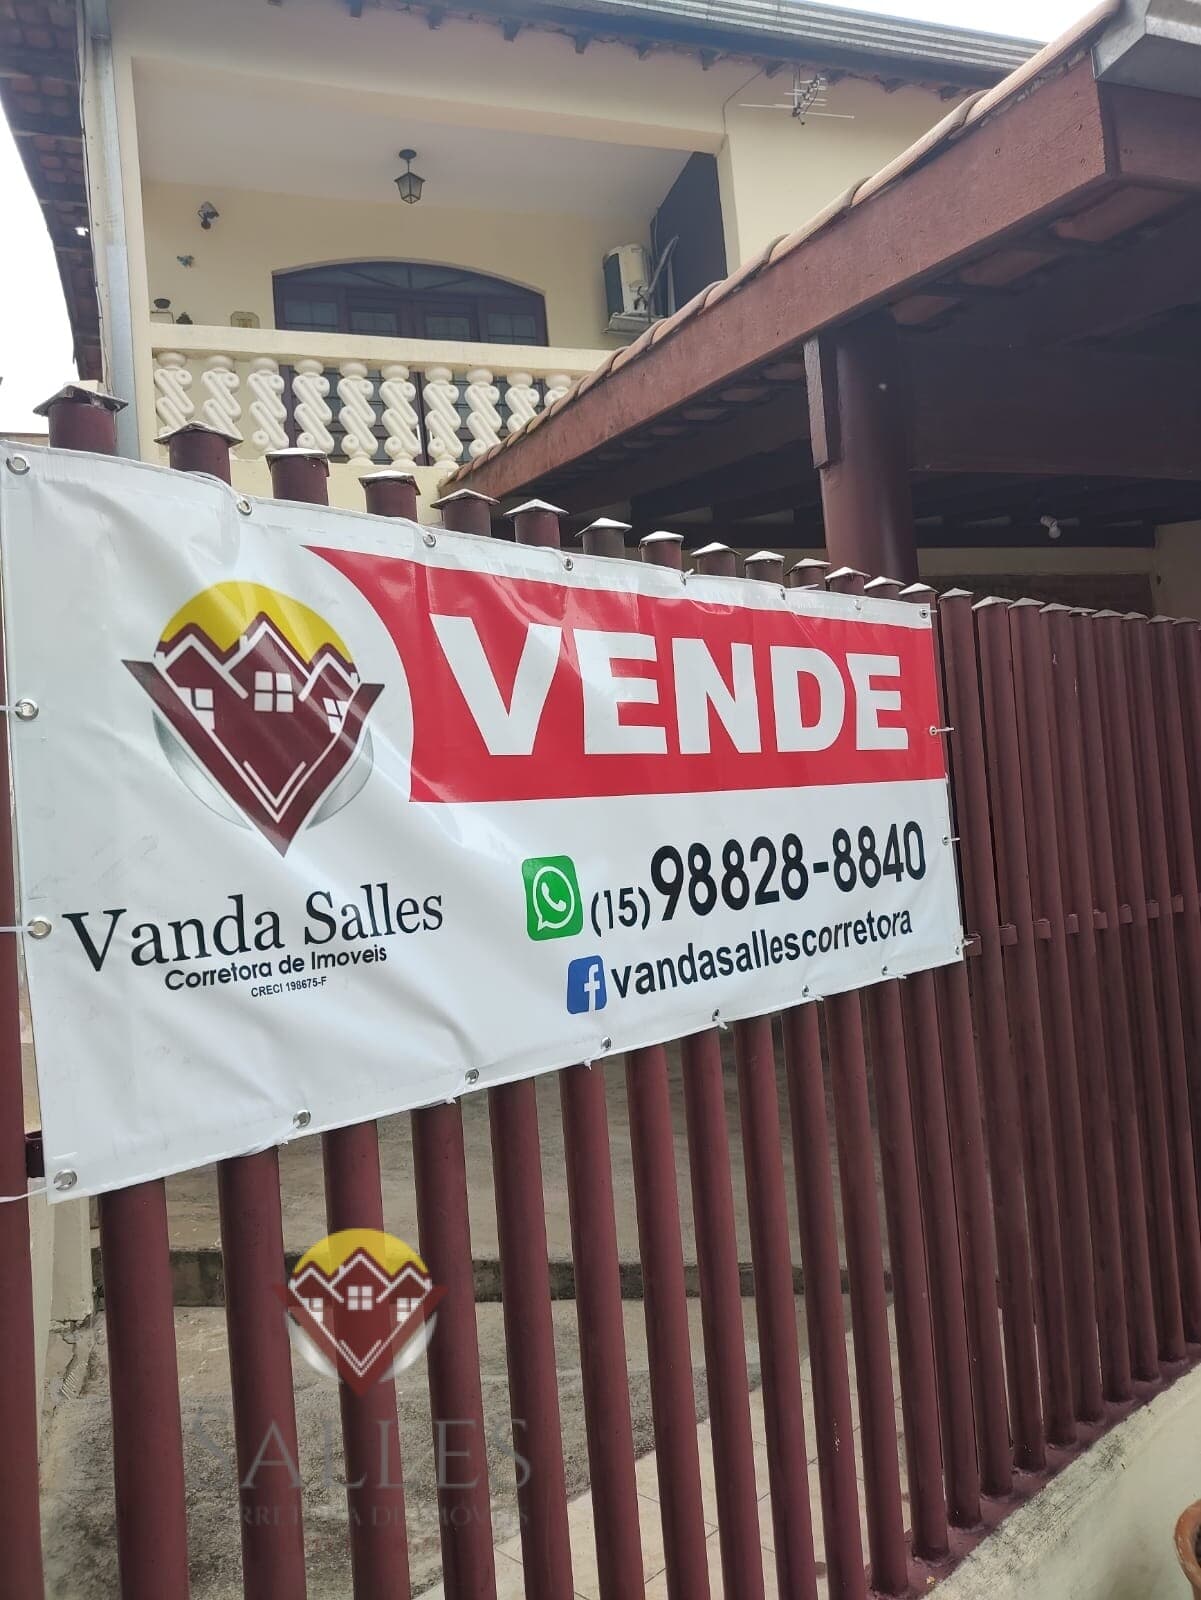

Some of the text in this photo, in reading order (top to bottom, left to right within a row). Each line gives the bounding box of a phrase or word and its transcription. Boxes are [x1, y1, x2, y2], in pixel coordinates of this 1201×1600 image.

[428, 612, 909, 756] VENDE
[62, 882, 444, 972] Vanda Salles
[164, 944, 388, 991] Corretora de Imoveis
[610, 911, 913, 999] vandasallescorretora
[250, 975, 328, 998] CRECI 198675-F
